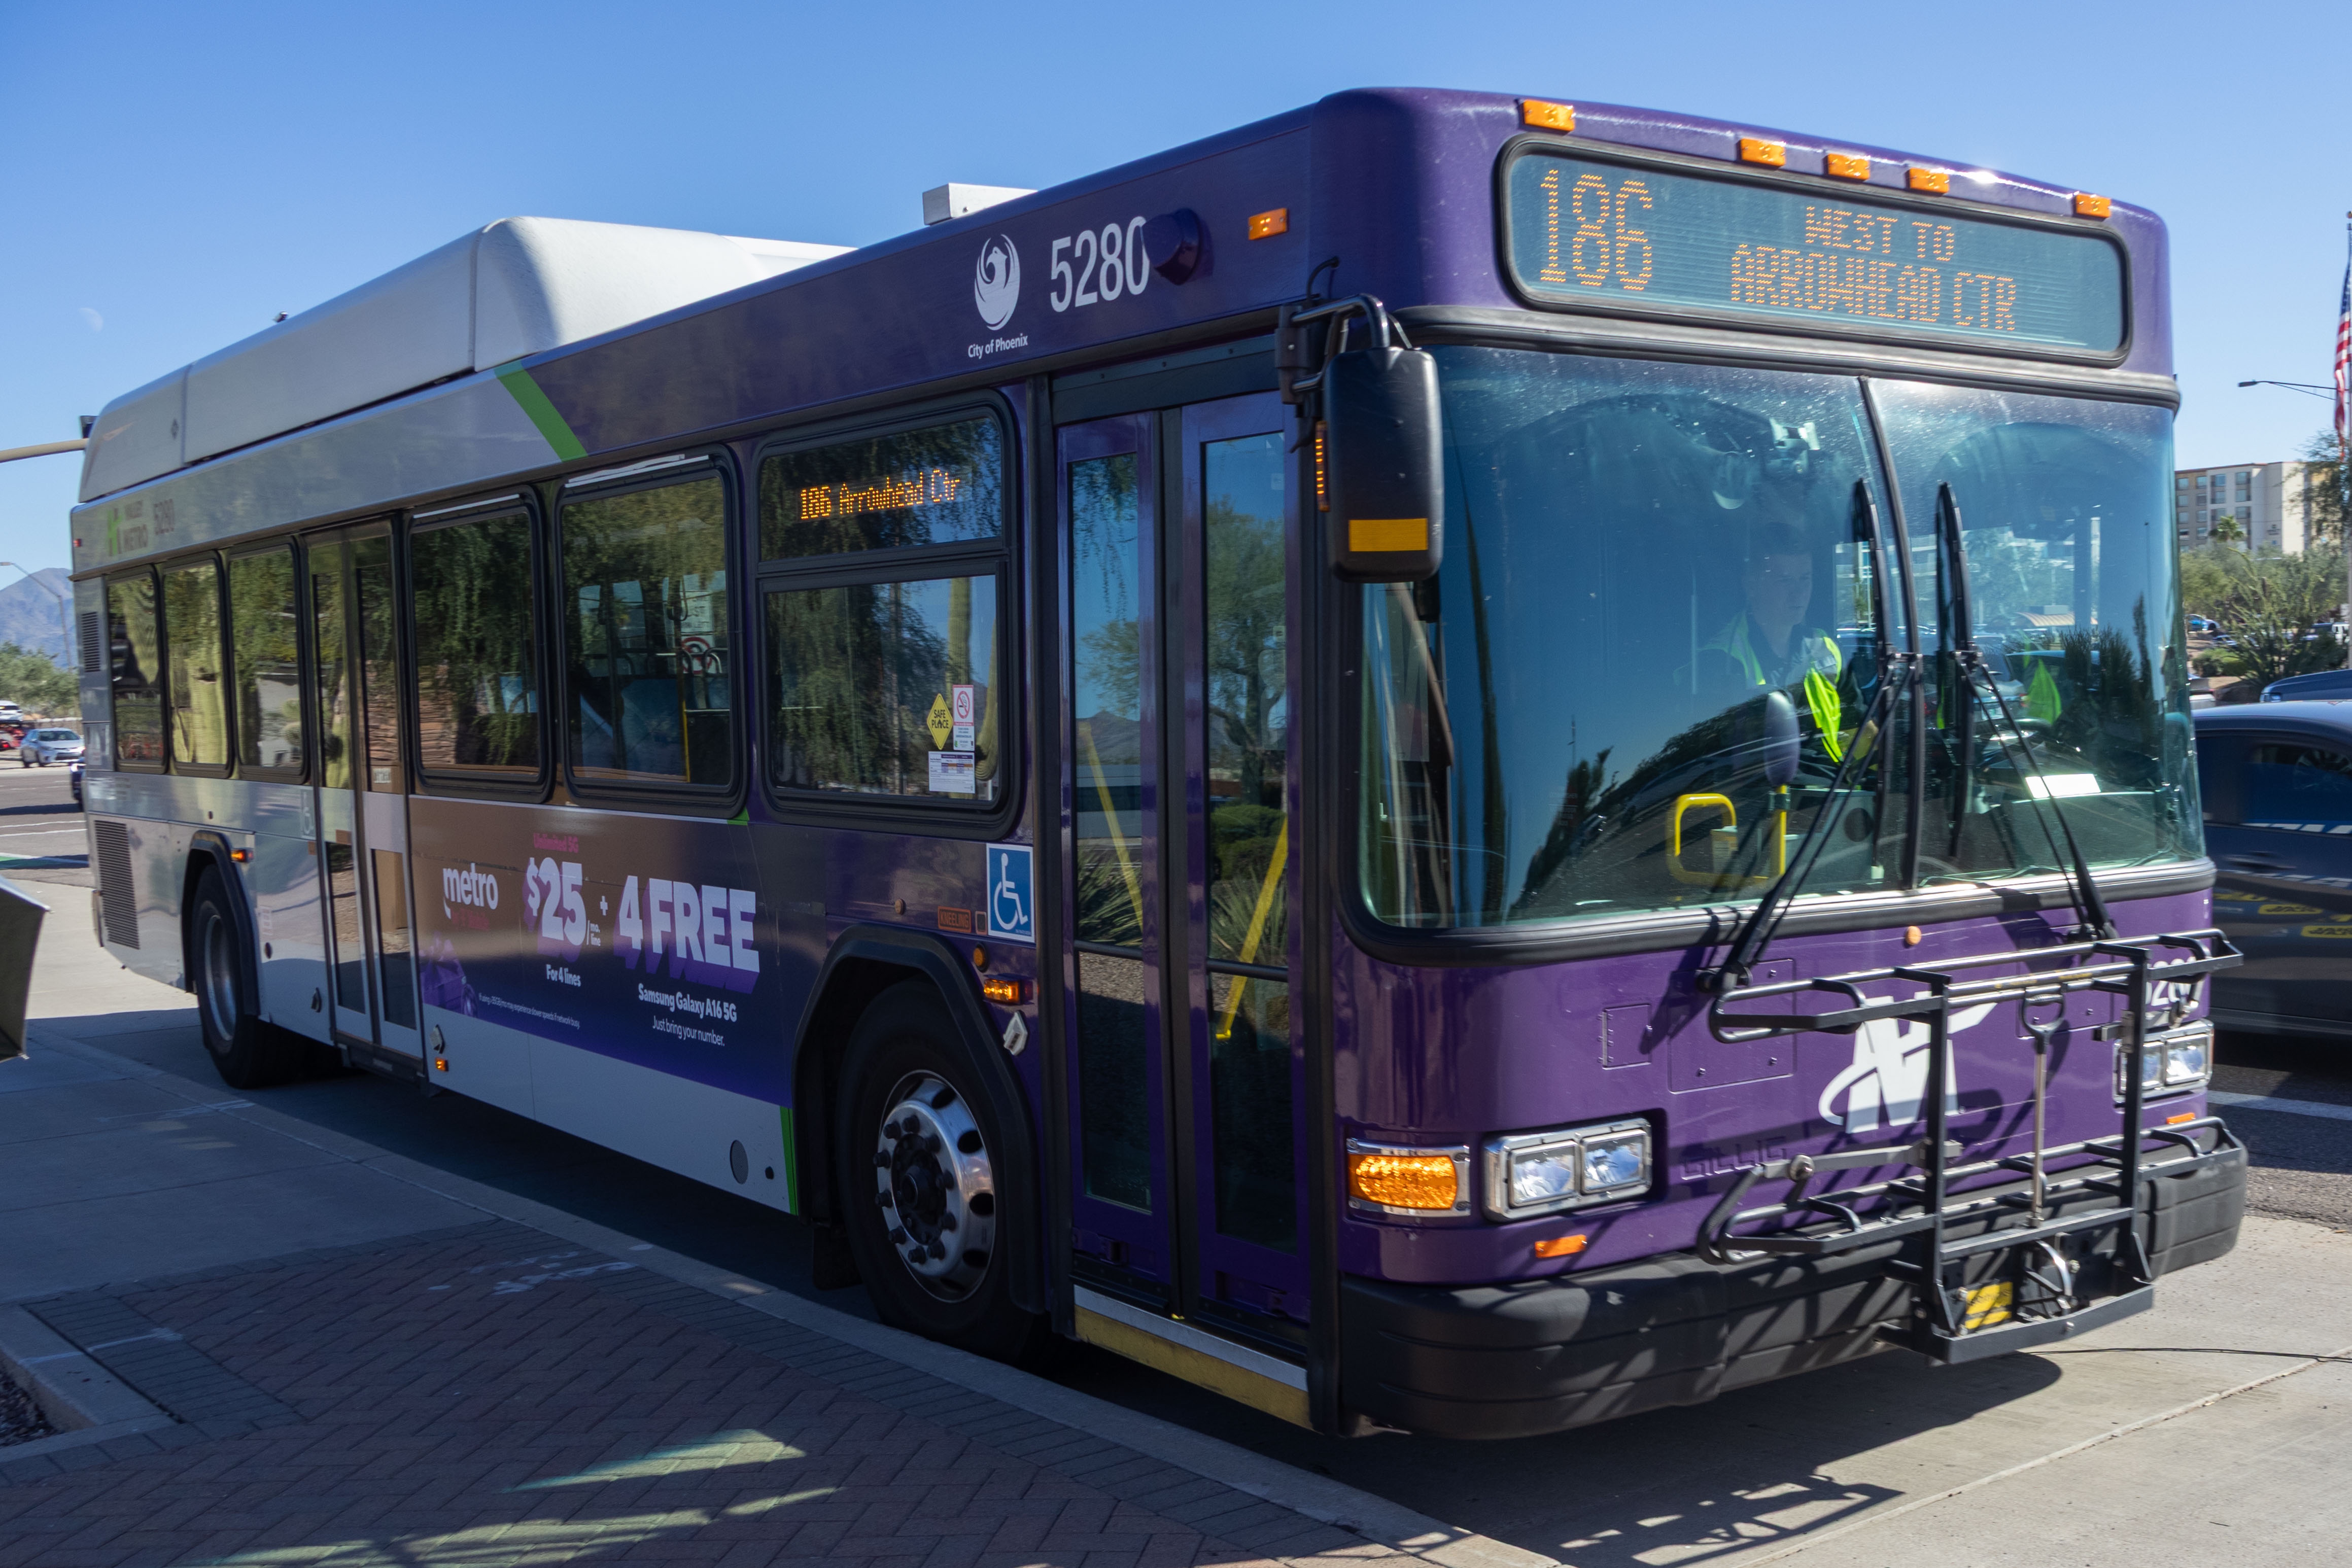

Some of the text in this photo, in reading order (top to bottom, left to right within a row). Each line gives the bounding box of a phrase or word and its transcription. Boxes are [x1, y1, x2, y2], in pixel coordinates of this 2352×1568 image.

[1539, 169, 1653, 291] 186
[1805, 205, 1955, 262] WEST TO
[1050, 216, 1150, 312] 5280
[1731, 242, 2017, 332] ARROWHEAD CTR
[968, 333, 1028, 359] City of Phoenix
[801, 469, 960, 519] 186 Arrowhead Ctr
[931, 719, 949, 729] PLACE
[933, 709, 946, 718] SAFE
[443, 862, 498, 911] metro
[527, 857, 586, 946] $25
[591, 933, 601, 947] line
[619, 875, 760, 972] 4 FREE
[940, 911, 969, 928] KNEELING
[546, 964, 581, 987] For 4 lines
[638, 983, 737, 1022] Samsung Galaxy A16 5G
[652, 1015, 725, 1047] Just bring your number.
[1681, 1136, 1787, 1180] GILLIG
